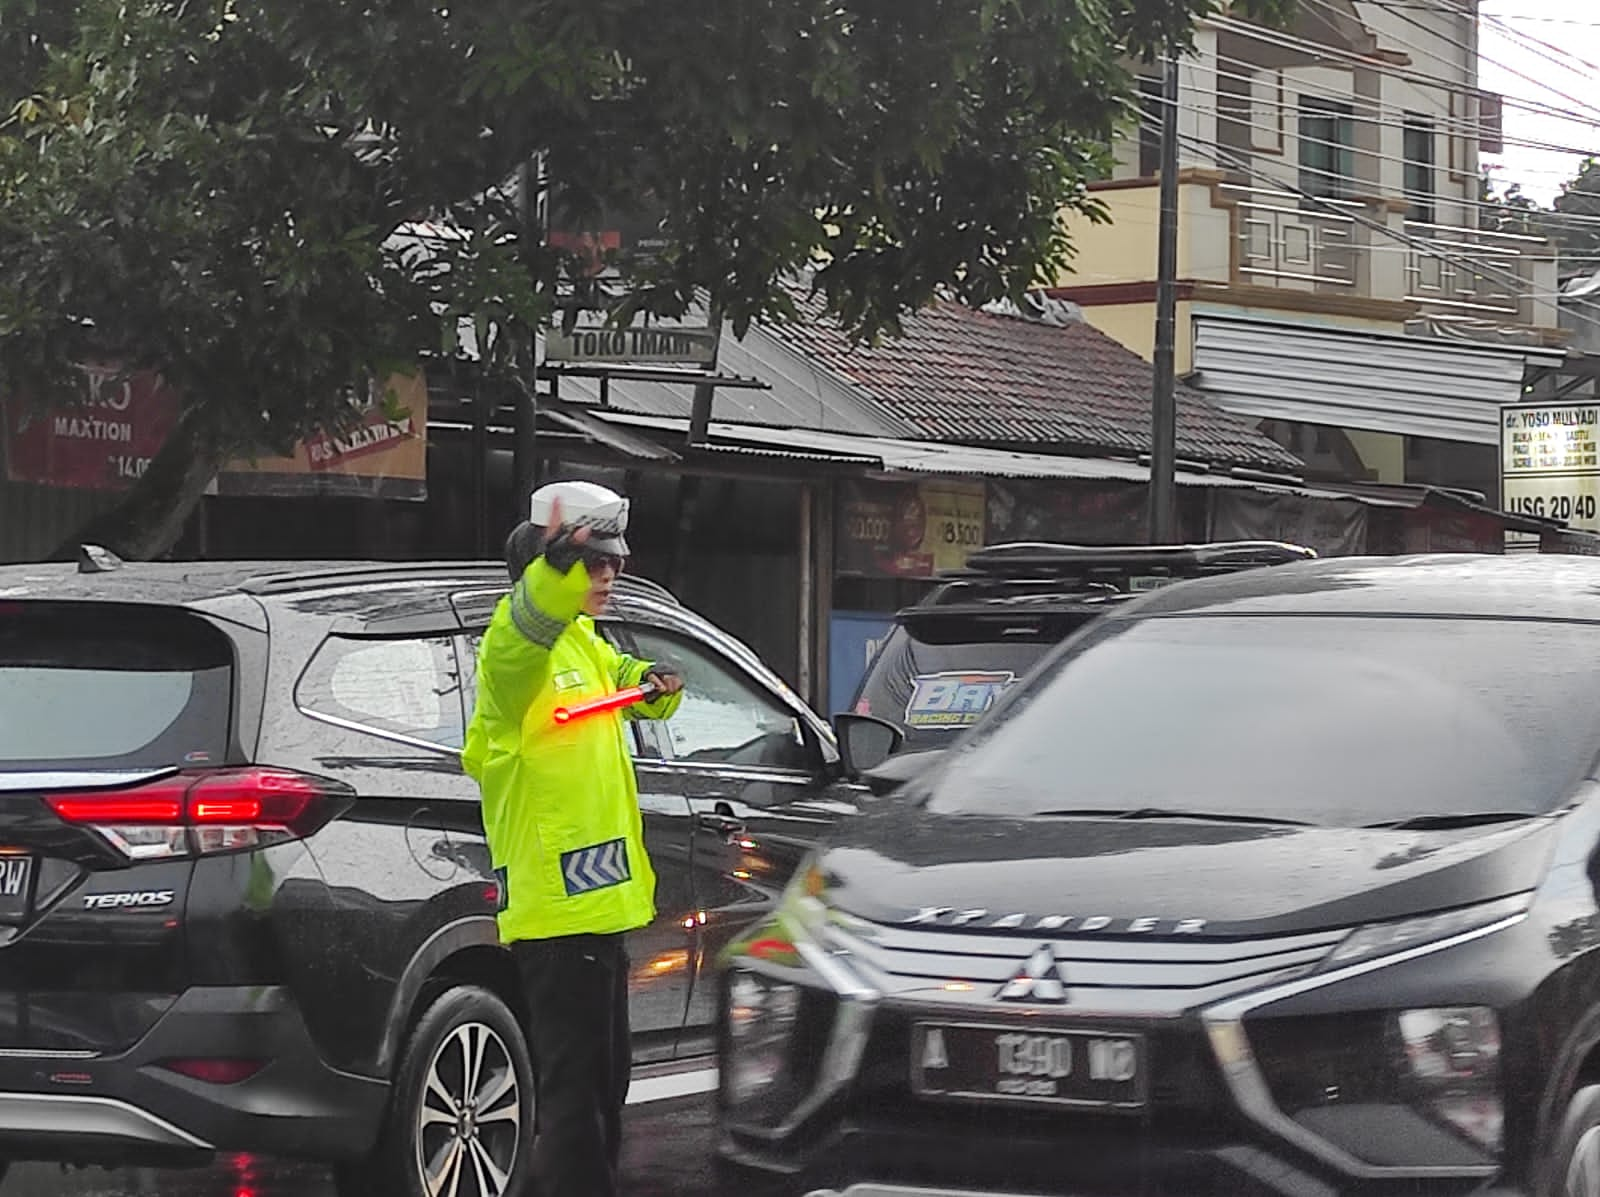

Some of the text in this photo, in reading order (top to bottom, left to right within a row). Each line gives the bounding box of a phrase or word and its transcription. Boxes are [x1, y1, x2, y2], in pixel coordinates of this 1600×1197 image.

[572, 332, 625, 356] TOKO
[55, 417, 132, 441] MAXTION
[1521, 411, 1550, 428] YOSO
[1552, 410, 1598, 426] MULYADI
[1511, 495, 1596, 519] USG 2D/4D
[83, 890, 175, 909] TERIOS
[902, 906, 1208, 934] XPANDER
[922, 1028, 949, 1069] A
